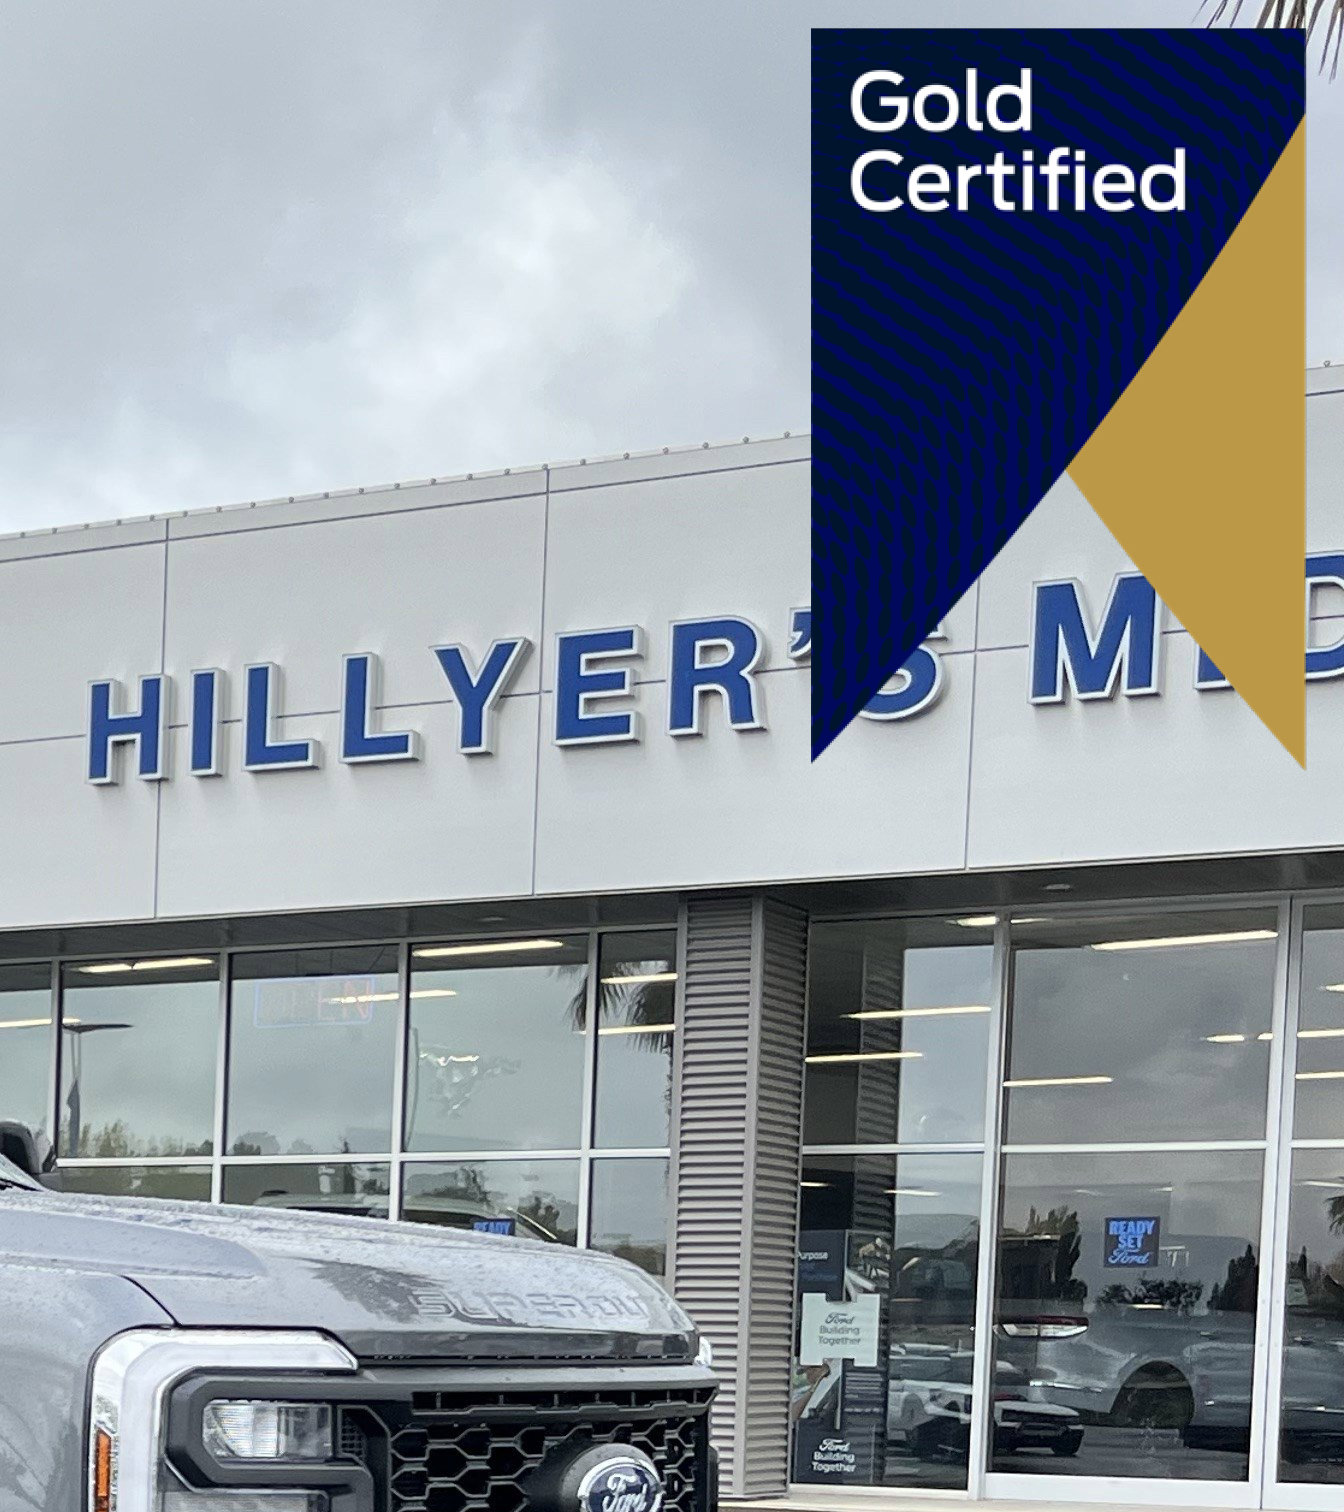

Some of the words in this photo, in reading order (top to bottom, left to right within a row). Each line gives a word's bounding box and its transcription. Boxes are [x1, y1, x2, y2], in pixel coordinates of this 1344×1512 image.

[1109, 1221, 1155, 1235] READY
[1118, 1234, 1143, 1248] SET
[1108, 1249, 1150, 1264] Ford
[825, 1311, 855, 1325] Ford
[819, 1325, 860, 1336] Building
[818, 1336, 861, 1347] Together
[819, 1439, 850, 1452] Ford
[814, 1452, 856, 1464] Building
[812, 1462, 857, 1473] Together
